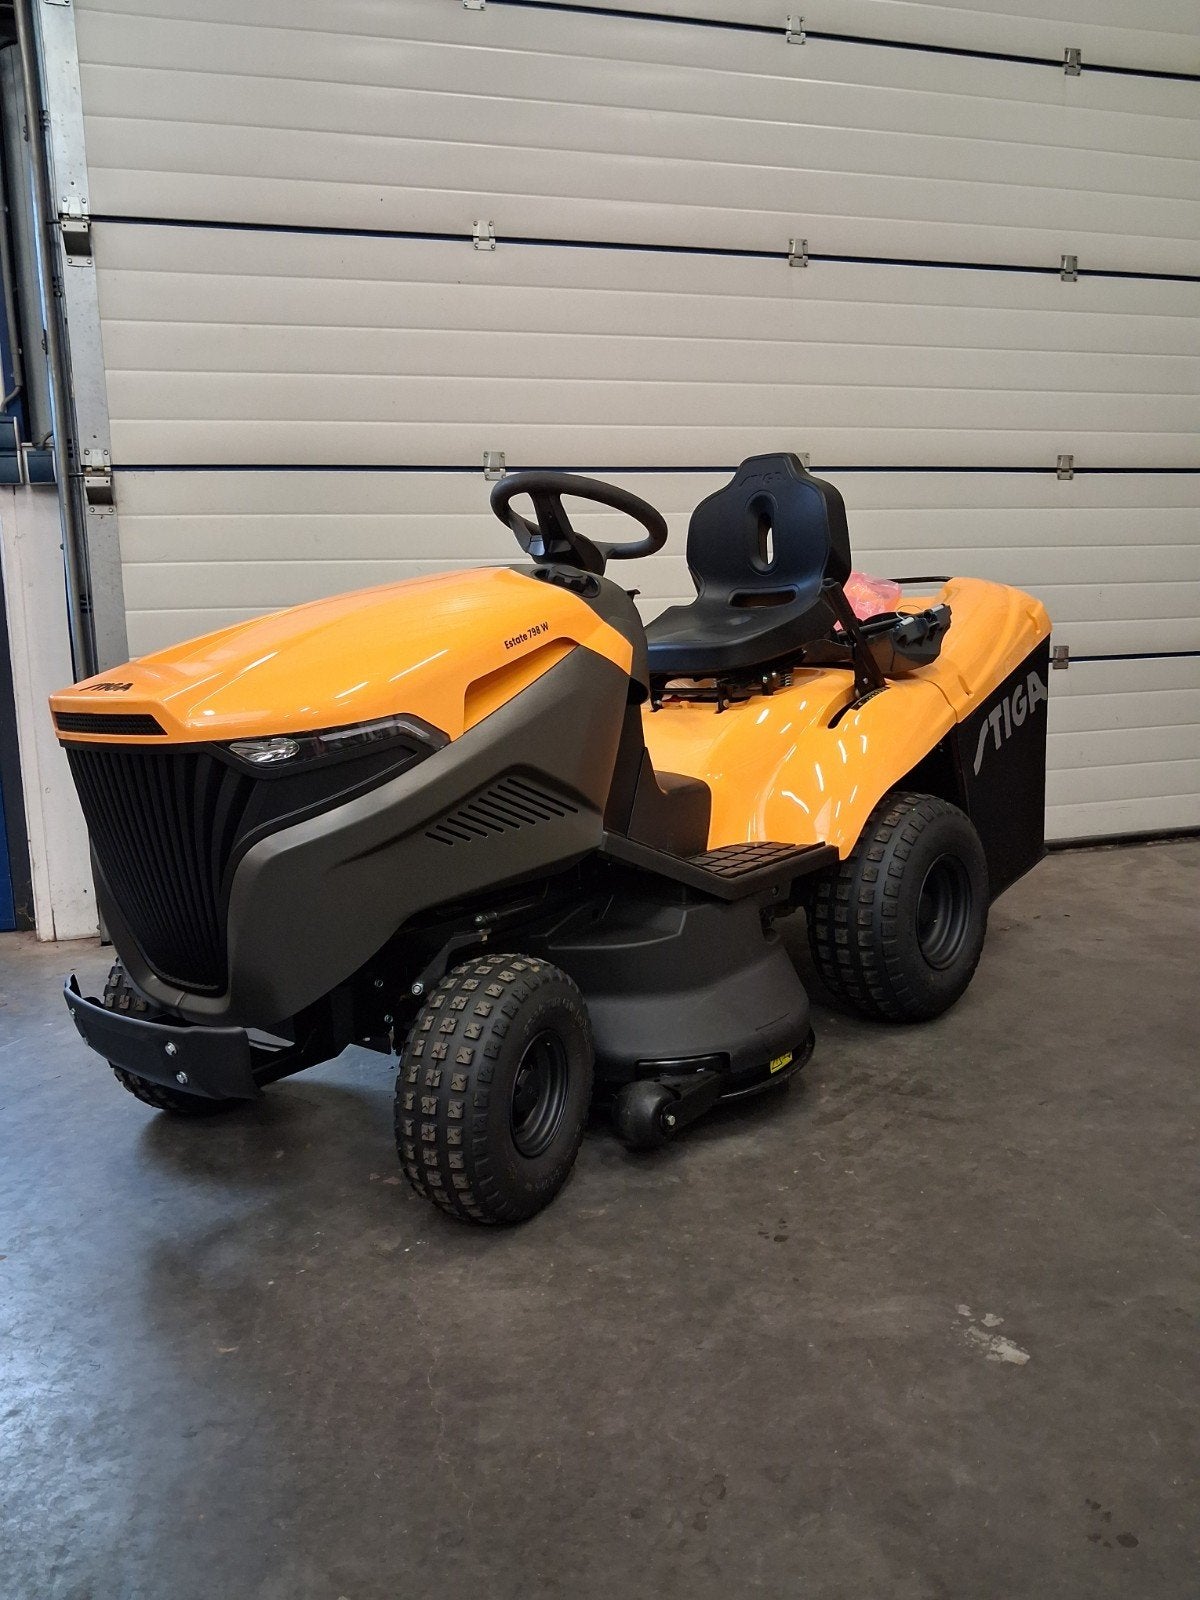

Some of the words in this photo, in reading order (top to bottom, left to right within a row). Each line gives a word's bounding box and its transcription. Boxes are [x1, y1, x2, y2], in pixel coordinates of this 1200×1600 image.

[504, 633, 528, 649] Estate
[527, 625, 541, 638] 798
[540, 621, 549, 631] W
[78, 682, 134, 692] STIGA
[973, 671, 1048, 776] STIGA
